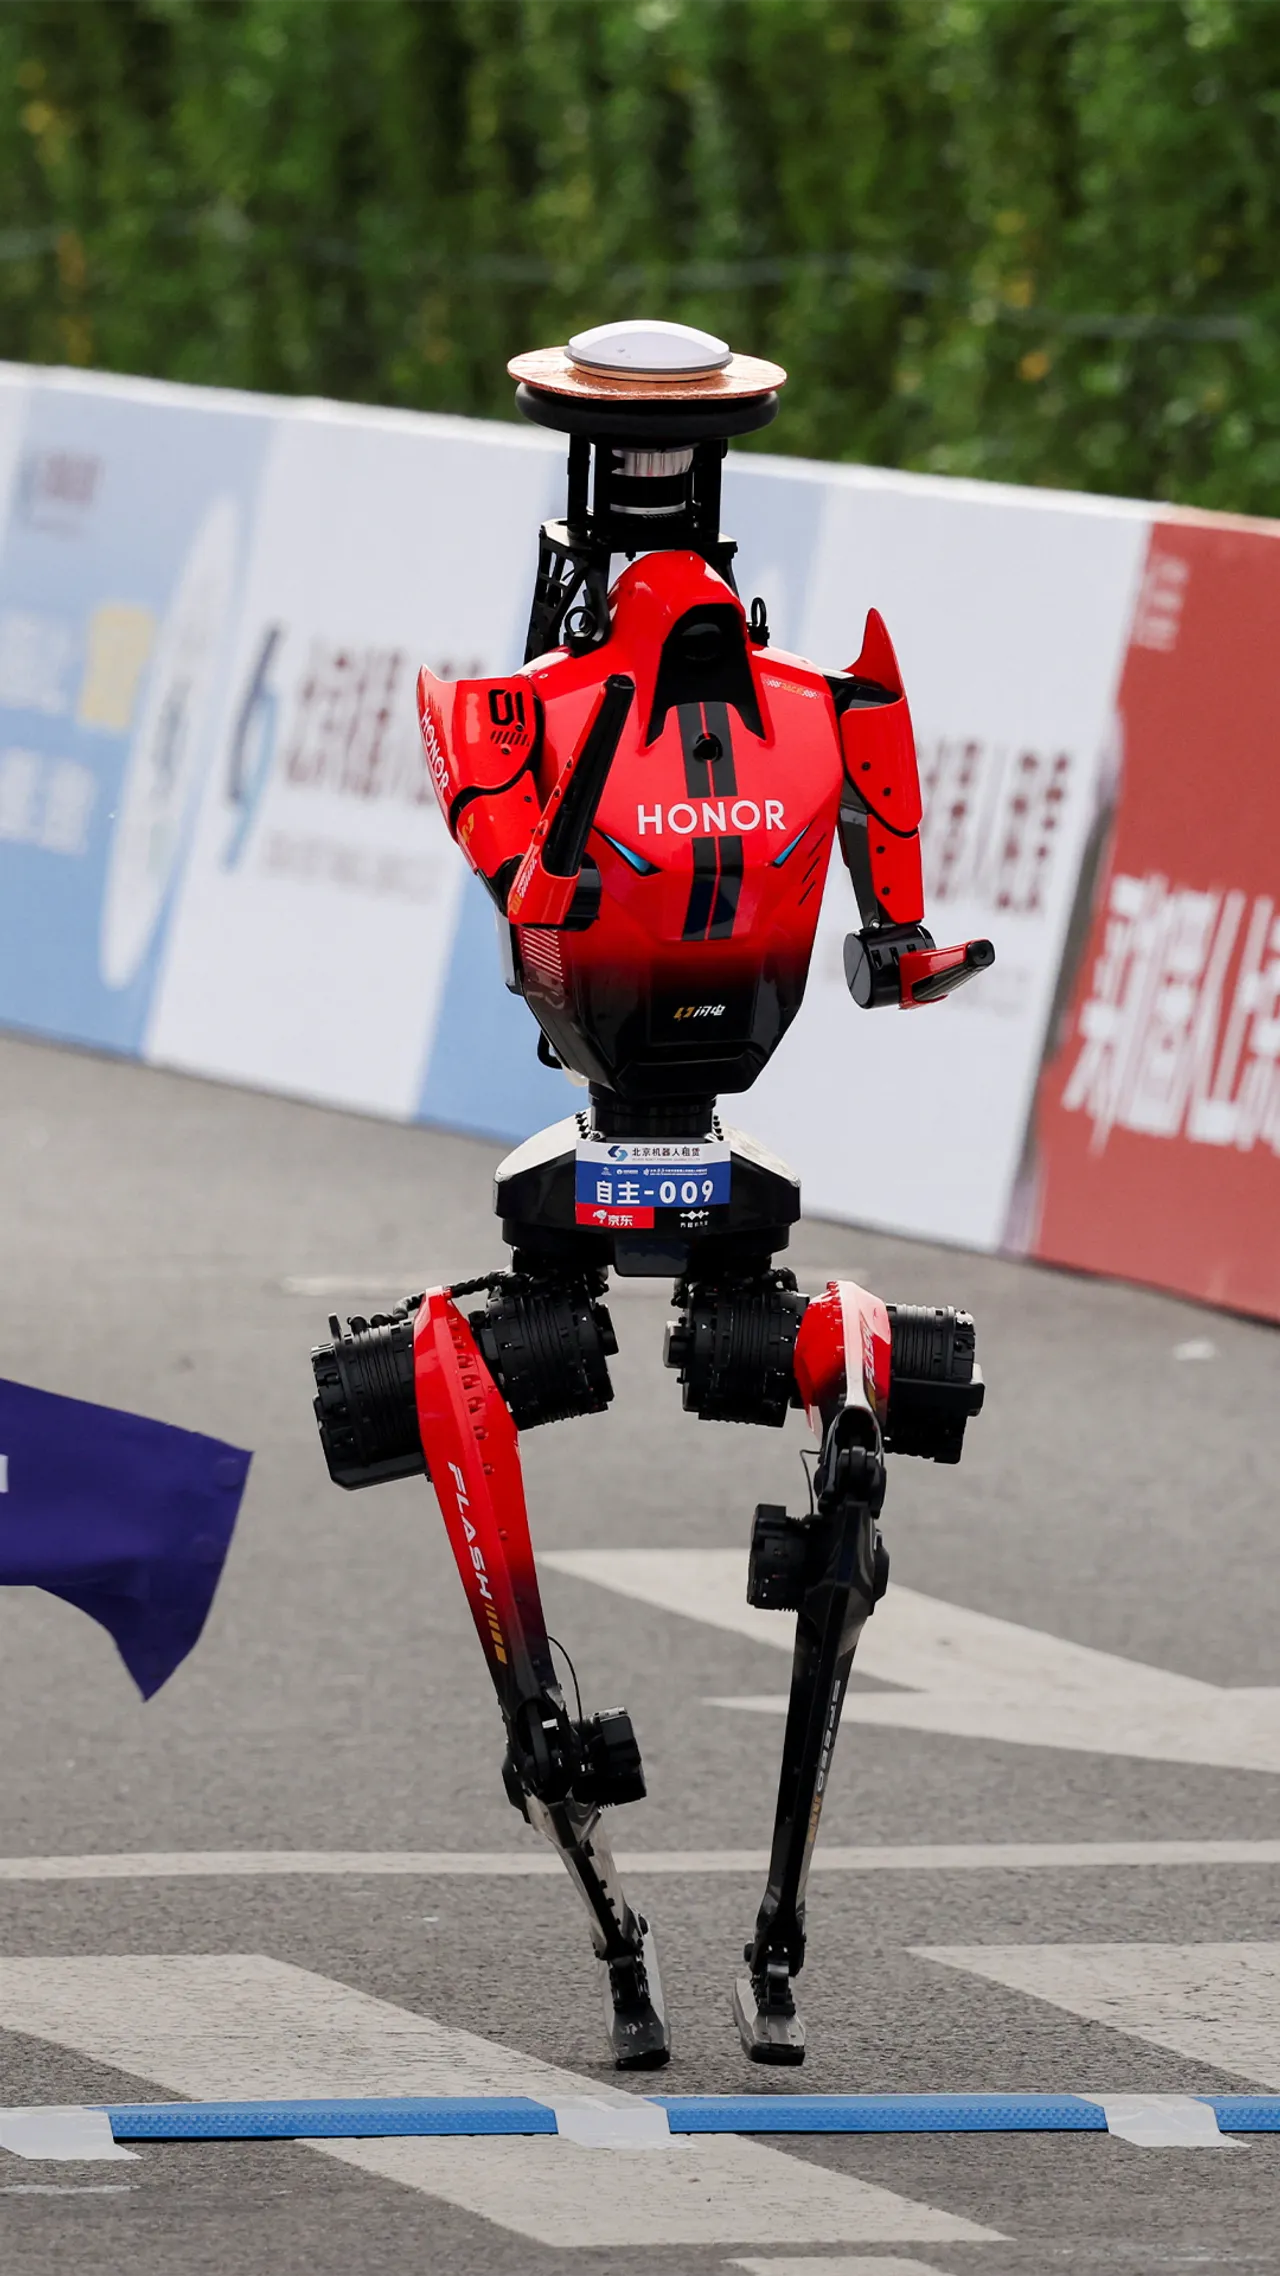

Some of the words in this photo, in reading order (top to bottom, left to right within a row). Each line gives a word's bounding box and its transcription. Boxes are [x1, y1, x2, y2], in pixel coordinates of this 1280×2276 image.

[488, 689, 526, 726] 01
[421, 708, 450, 791] HONOR
[637, 800, 787, 835] HONOR
[693, 1004, 726, 1018] 闪电
[632, 1146, 701, 1157] 北京机器人租赁
[596, 1180, 714, 1205] 自主-009
[608, 1214, 634, 1227] 京东
[447, 1461, 493, 1601] FLASH
